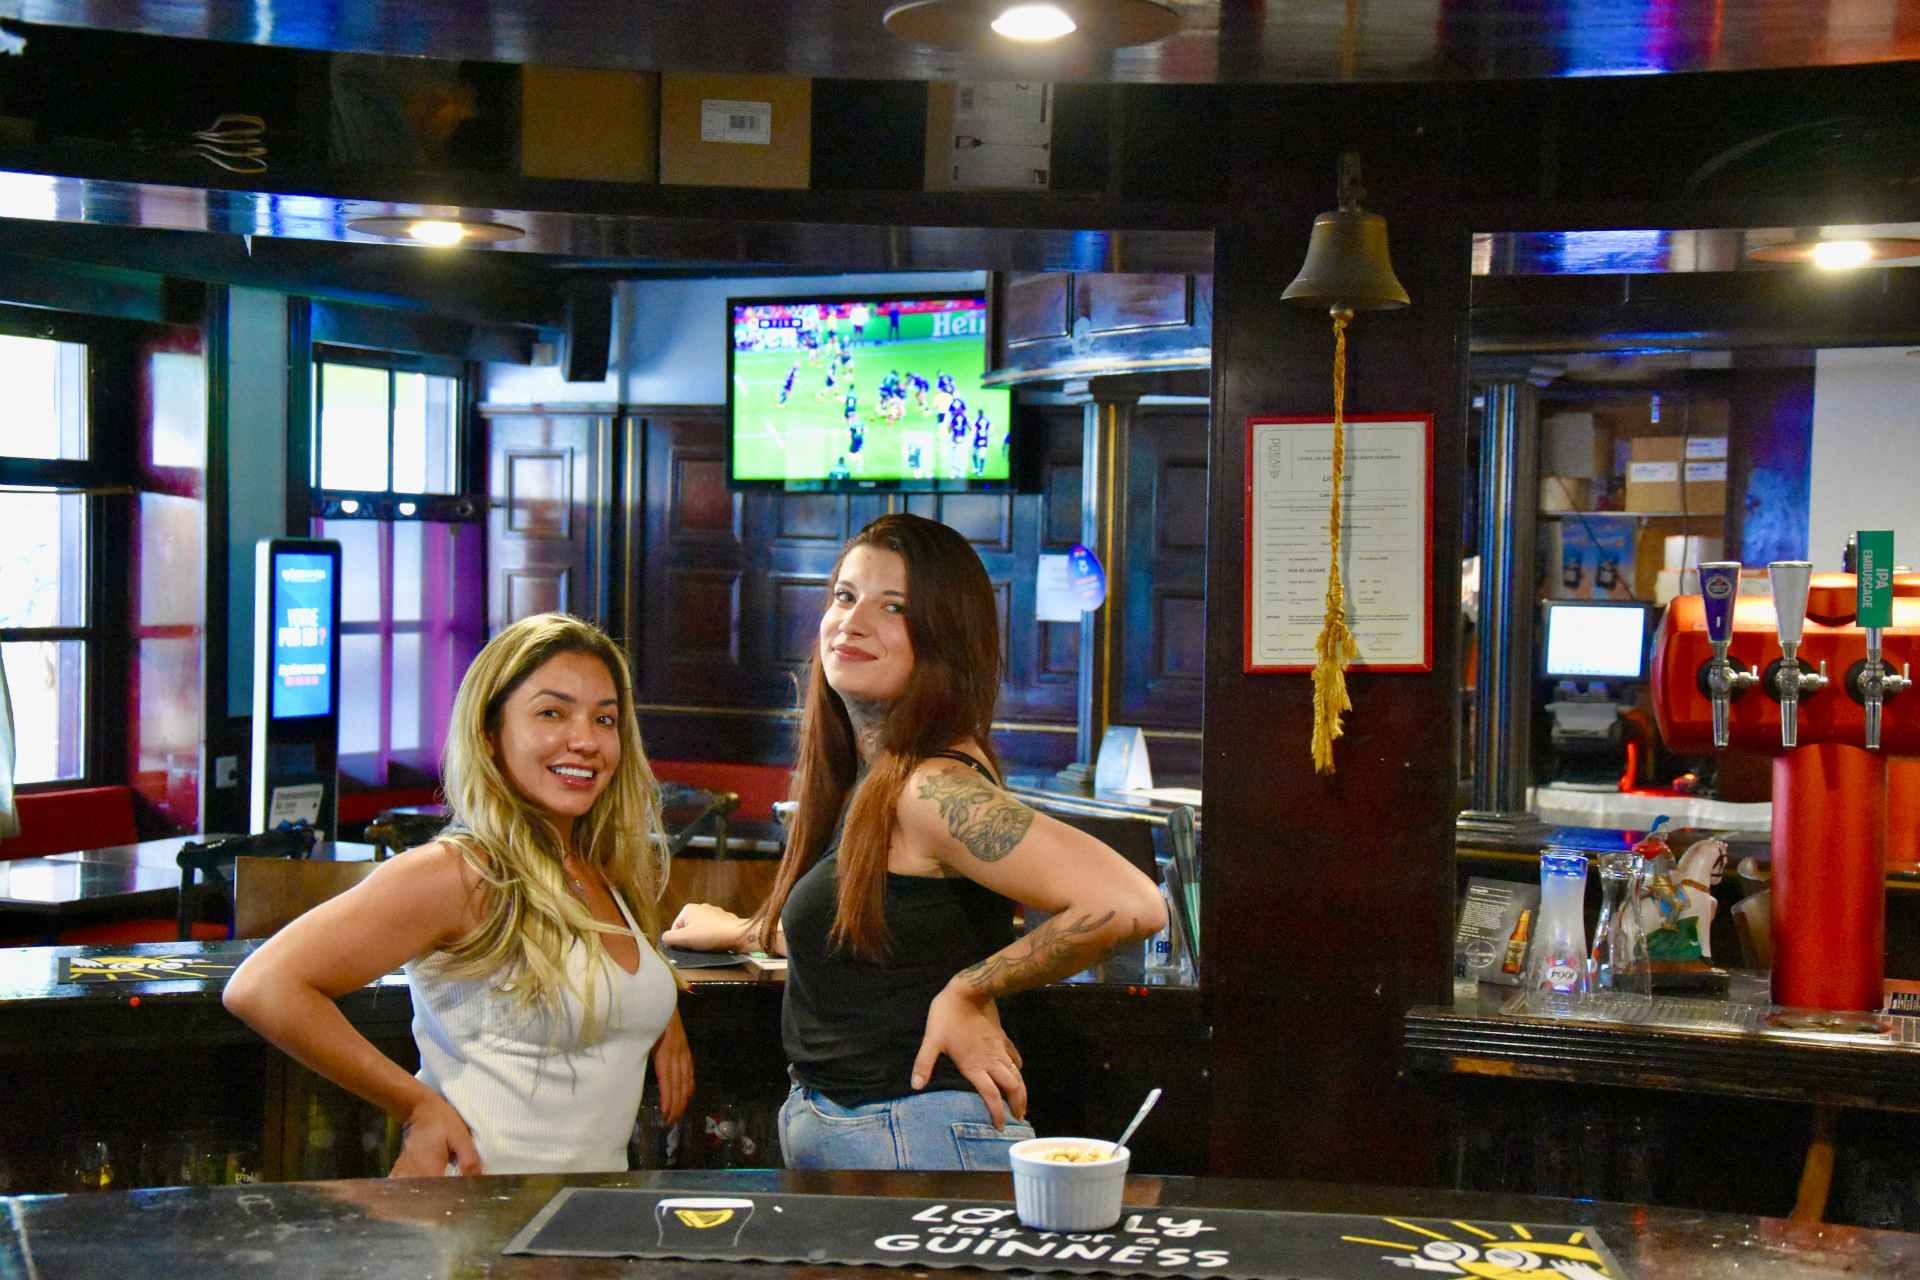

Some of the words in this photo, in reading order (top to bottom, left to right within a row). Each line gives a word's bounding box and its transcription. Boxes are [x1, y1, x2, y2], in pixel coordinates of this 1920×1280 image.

[1270, 438, 1281, 465] vaud
[1862, 549, 1873, 608] EMBUSCADE
[1876, 568, 1889, 589] IPA
[1551, 970, 1575, 981] 1664
[912, 1204, 1217, 1238] LOLY
[927, 1224, 1023, 1239] day
[1136, 1236, 1160, 1246] a
[874, 1233, 1231, 1268] GUINNESS
